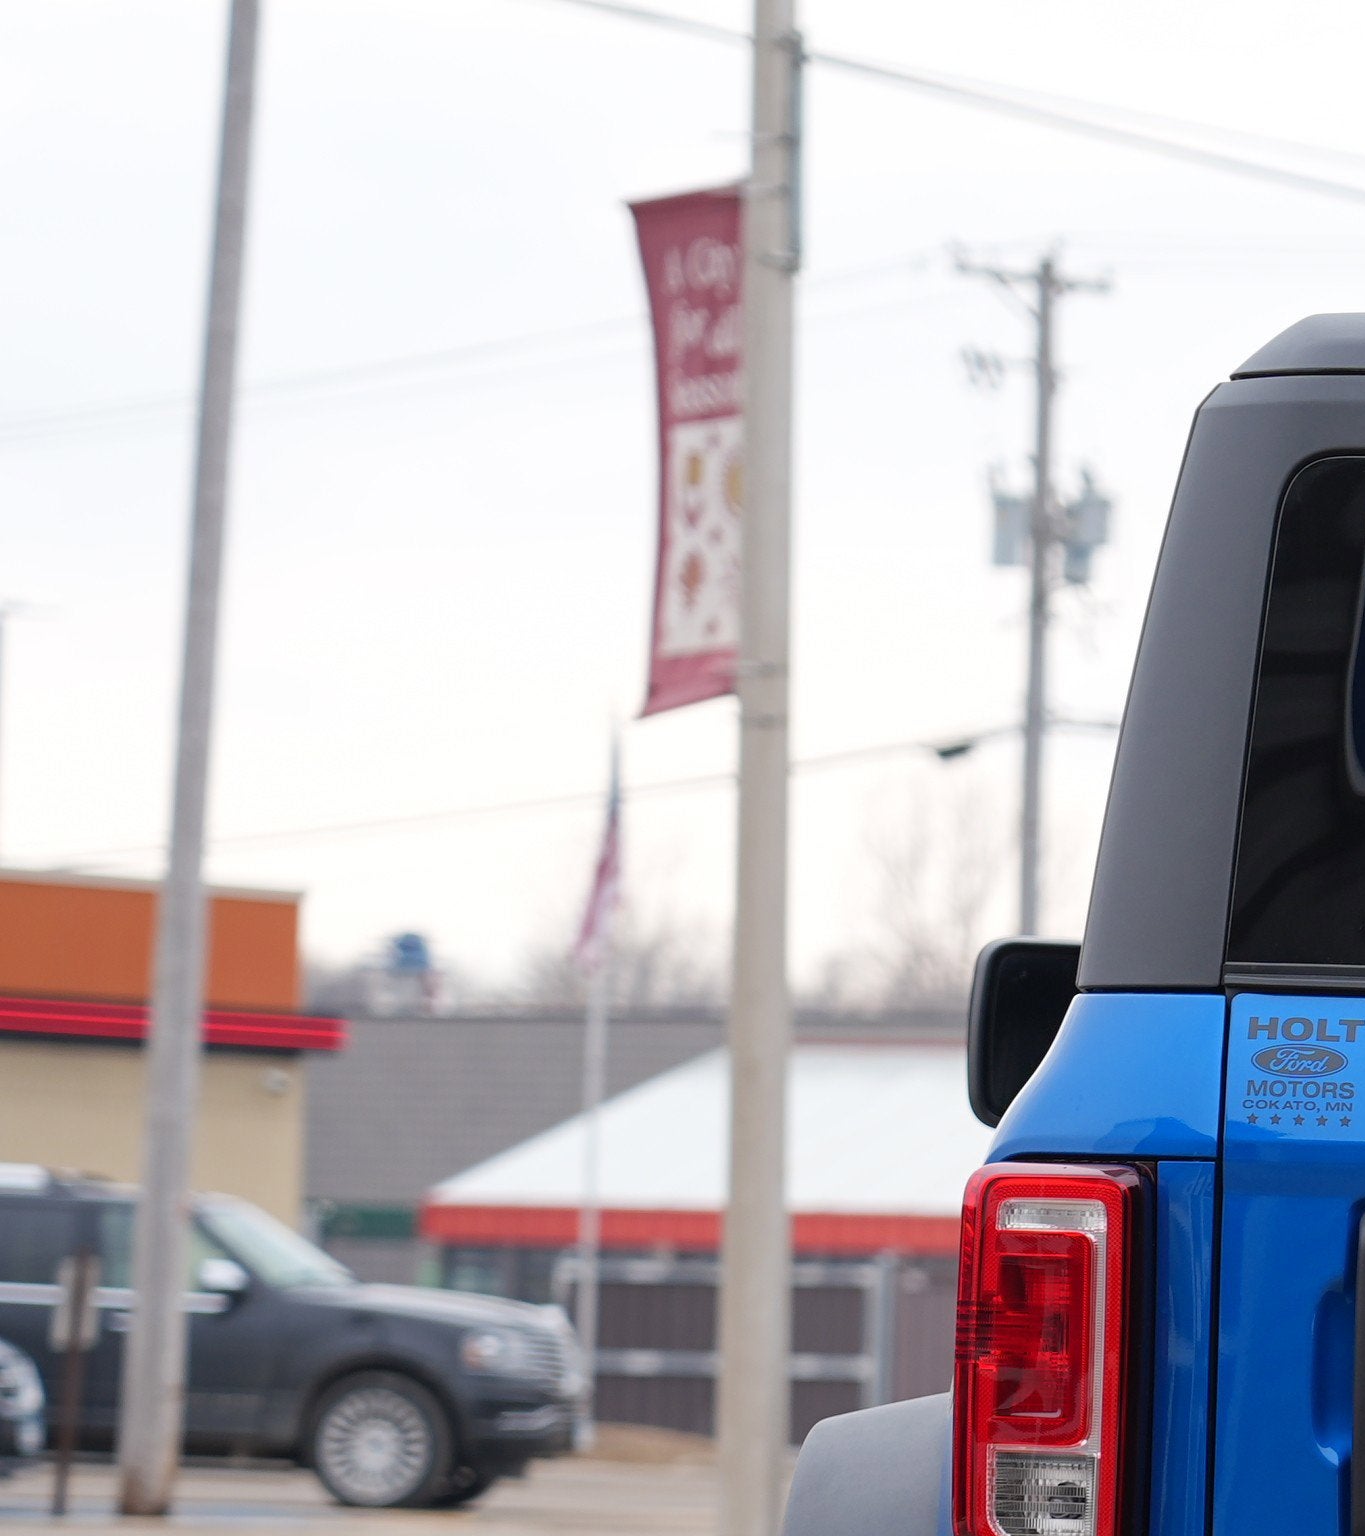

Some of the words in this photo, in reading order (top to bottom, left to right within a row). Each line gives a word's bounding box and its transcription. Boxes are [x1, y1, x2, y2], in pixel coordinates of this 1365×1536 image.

[1248, 1016, 1365, 1042] HOLT
[1246, 1080, 1355, 1099] MOTORS
[1242, 1099, 1321, 1113] COKATO,
[1325, 1102, 1354, 1112] MN
